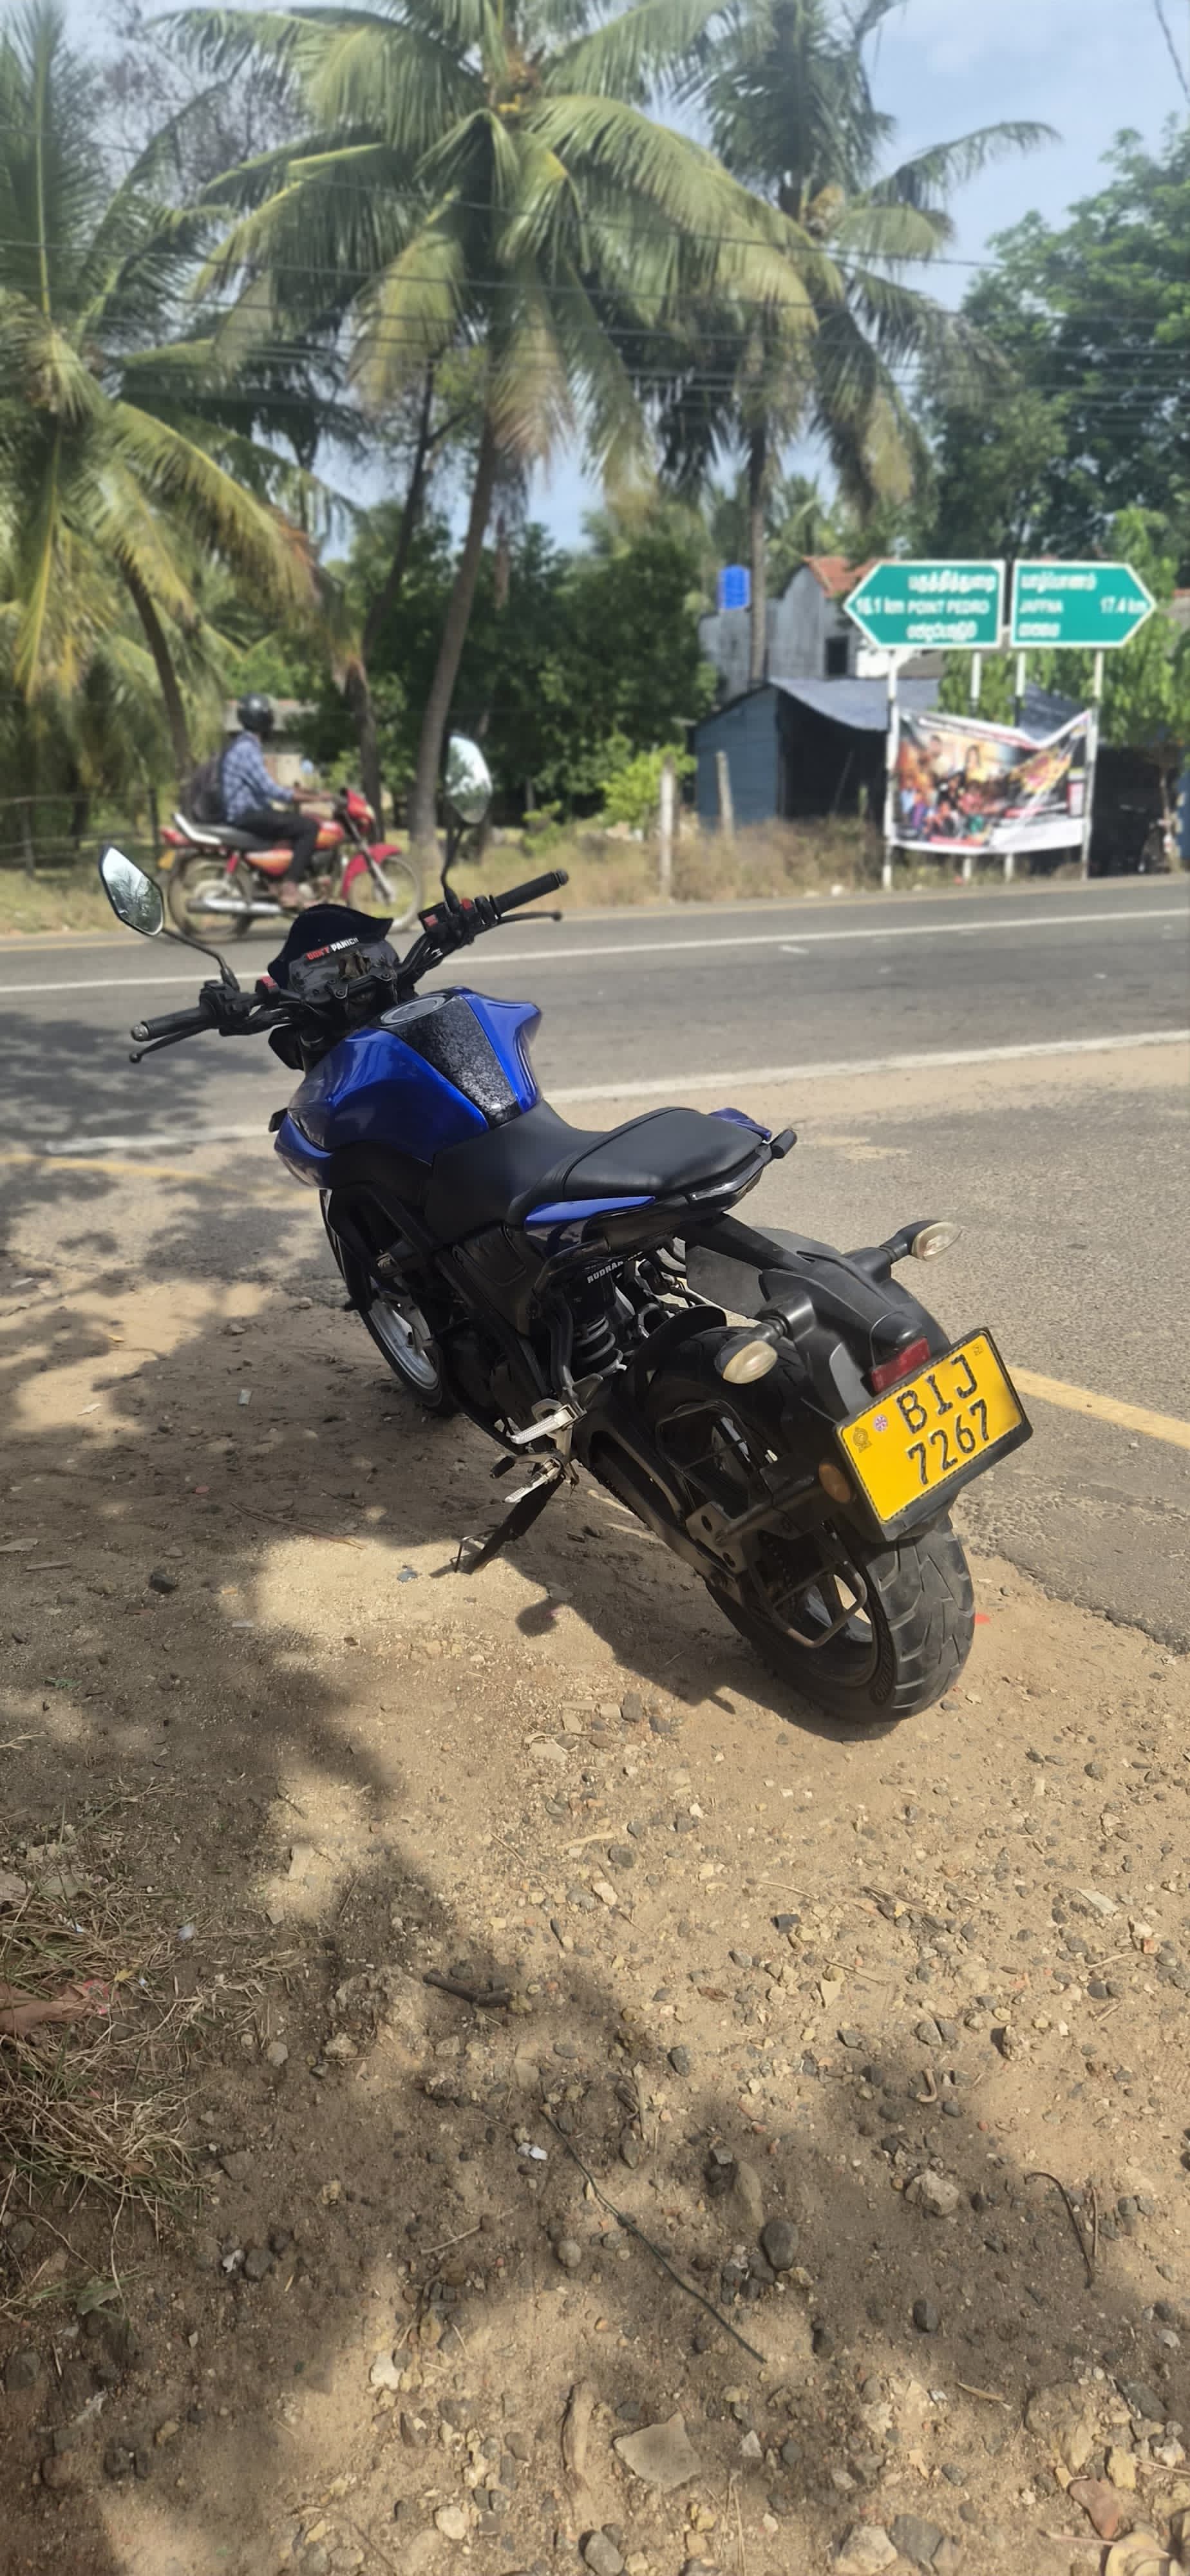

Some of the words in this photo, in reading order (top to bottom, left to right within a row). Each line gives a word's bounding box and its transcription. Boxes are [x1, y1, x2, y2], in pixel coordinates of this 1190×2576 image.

[907, 600, 945, 615] POINT
[896, 1354, 978, 1434] BIJ
[905, 1399, 990, 1485] 7267
